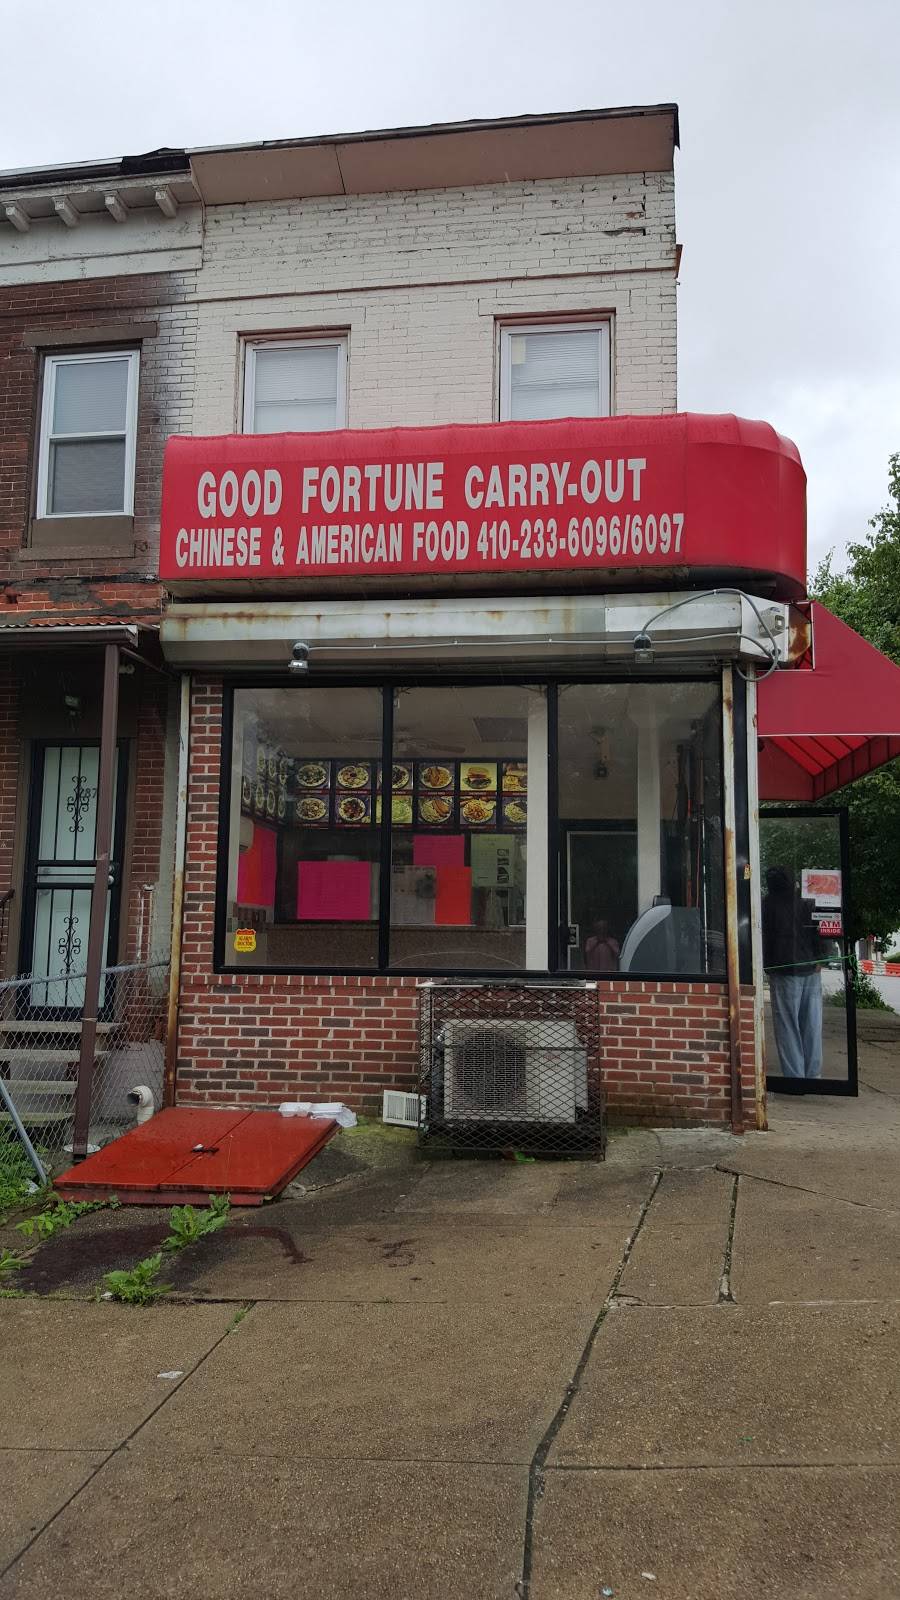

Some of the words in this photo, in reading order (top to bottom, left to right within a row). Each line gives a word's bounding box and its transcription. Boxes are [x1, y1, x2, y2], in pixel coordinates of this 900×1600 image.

[197, 469, 283, 519] GOOD
[302, 461, 444, 512] FORTUNE
[464, 457, 648, 510] CARRY-OUT
[175, 526, 262, 568] CHINESE
[271, 526, 285, 566] &
[295, 520, 403, 565] AMERICAN
[412, 519, 470, 563] FOOD
[477, 513, 685, 560] 410-233-6096/6097
